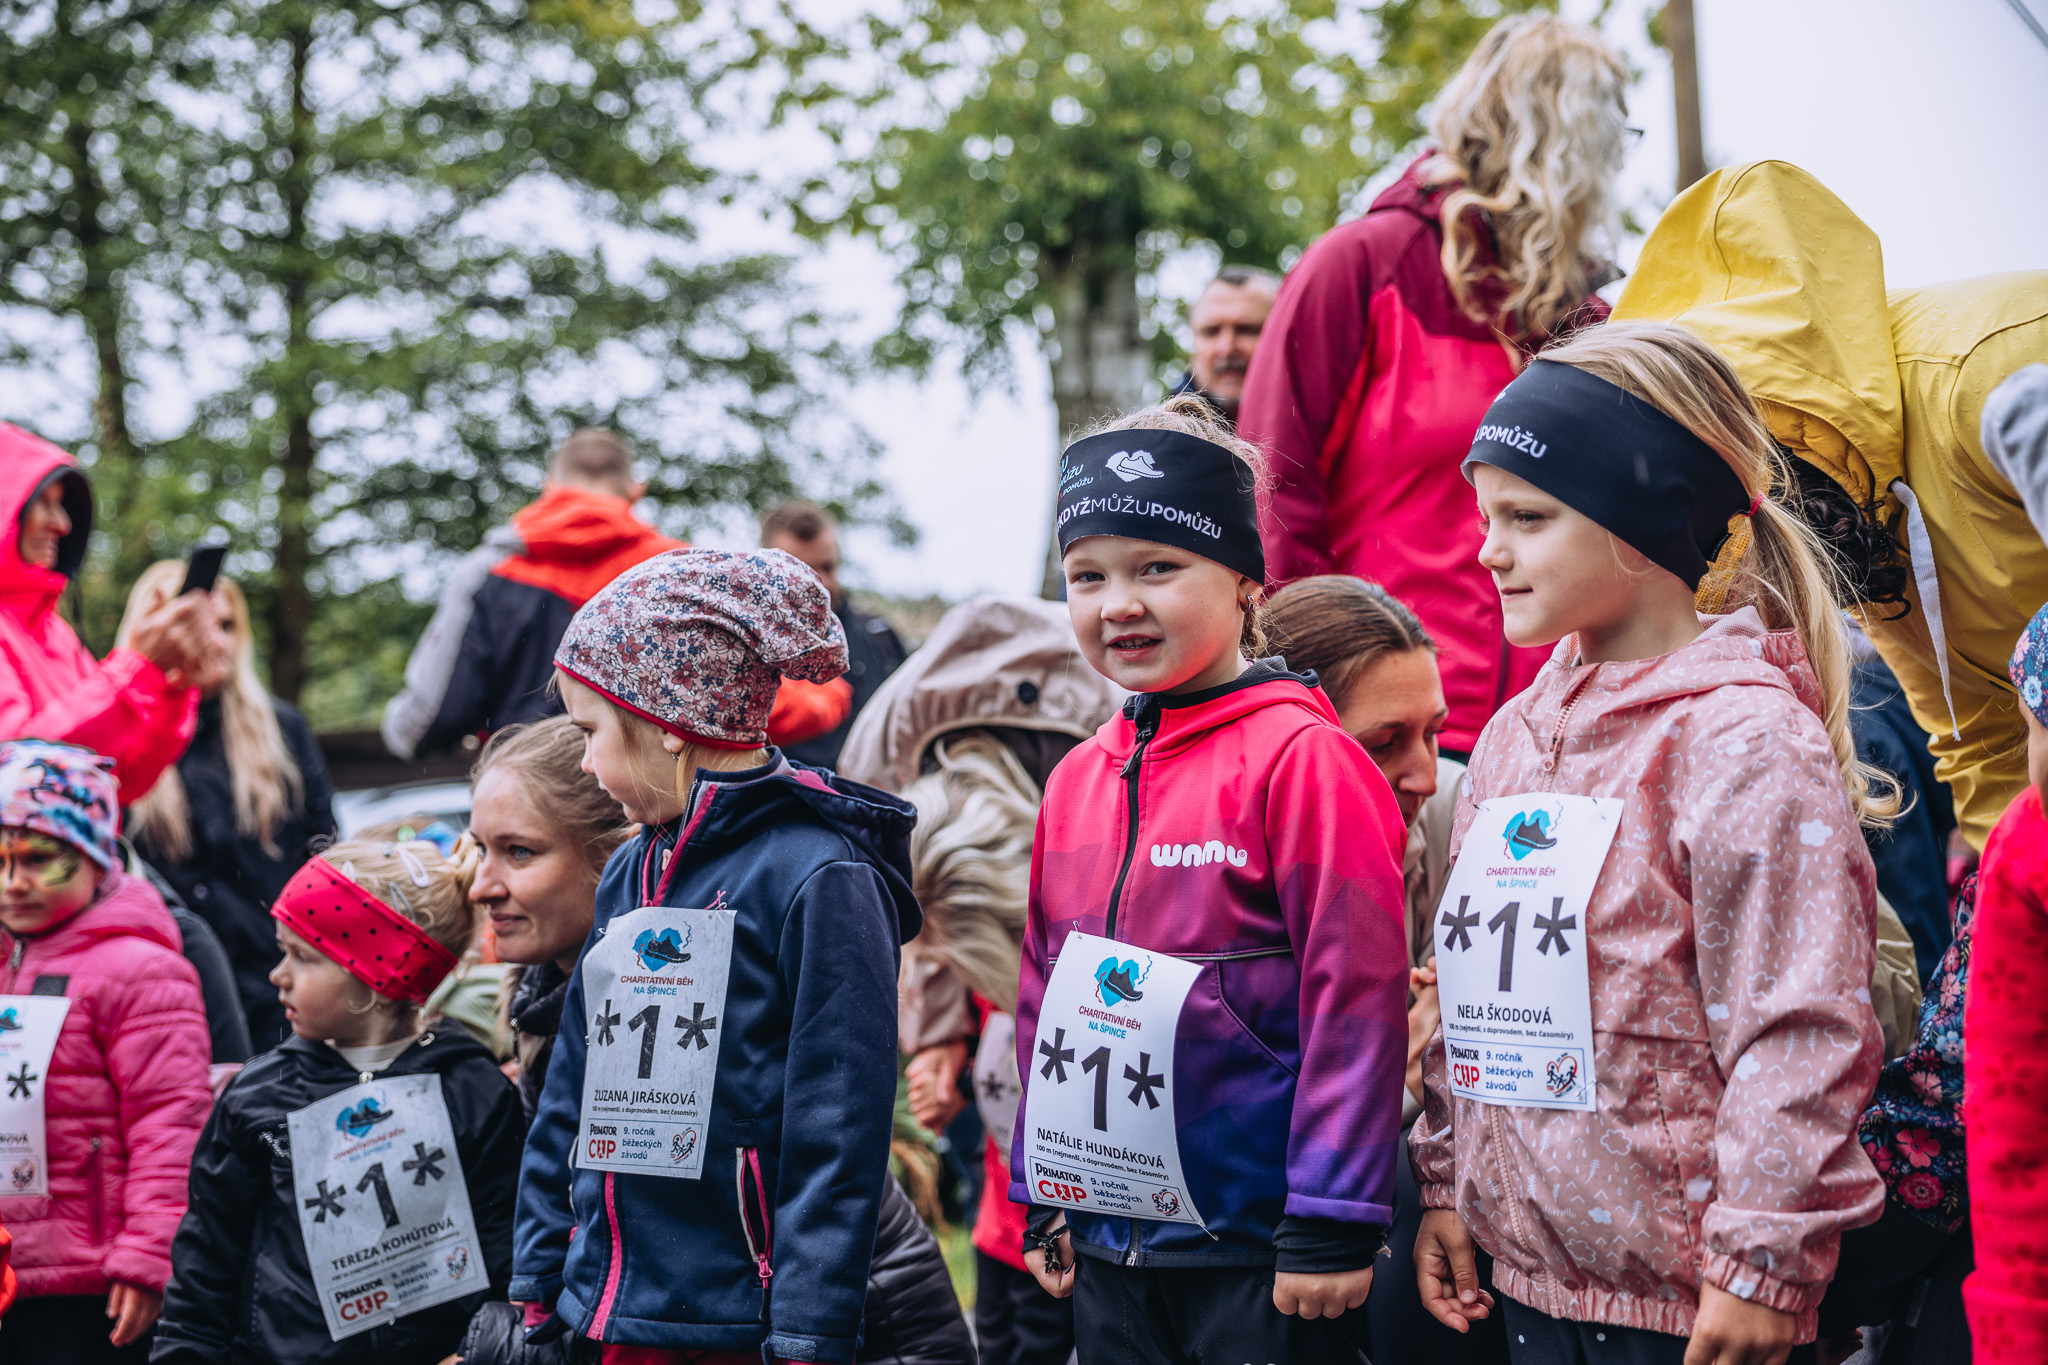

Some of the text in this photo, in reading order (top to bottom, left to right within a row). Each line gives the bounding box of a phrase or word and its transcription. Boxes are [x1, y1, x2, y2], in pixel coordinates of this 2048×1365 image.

[1472, 424, 1547, 458] UPOMŮŽU
[1486, 867, 1555, 876] CHARITATIVNÍ BĚH
[1496, 877, 1538, 888] NA ŠPINCE
[621, 974, 694, 986] CHARITATIVNÍ BĚH
[633, 985, 677, 995] NA ŠPINCE
[1078, 1005, 1141, 1031] CHARITATIVNÍ BĚH
[1457, 1003, 1552, 1024] NELA ŠKODOVÁ
[1088, 1020, 1126, 1039] NA ŠPINCE
[1487, 1027, 1524, 1036] doprovodem,
[1539, 1031, 1573, 1040] časomíry)
[1450, 1044, 1479, 1061] PRIMATOR
[1486, 1051, 1522, 1062] 9. ročník
[1454, 1063, 1479, 1088] CUP
[1486, 1065, 1533, 1079] běžeckých
[1486, 1081, 1517, 1091] závodů
[594, 1088, 696, 1105] ZUZANA JIRÁSKOVÁ
[671, 1109, 698, 1117] časomíry)
[590, 1123, 617, 1136] PRIMATOR
[632, 1127, 655, 1136] ročník
[589, 1139, 616, 1159] CUP
[622, 1139, 662, 1149] běžeckých
[1037, 1127, 1165, 1170] NATÁLIE HUNDÁKOVÁ
[622, 1151, 648, 1159] závodů
[1036, 1144, 1045, 1152] 100
[1052, 1148, 1080, 1163] (nejmenší,
[1086, 1155, 1125, 1173] doprovodem,
[1127, 1166, 1138, 1174] bez
[1138, 1167, 1169, 1181] časomíry)
[1035, 1162, 1083, 1184] PRIMATOR
[1038, 1180, 1087, 1204] CUP
[1090, 1177, 1130, 1192] 9. ročník
[1094, 1188, 1143, 1204] běžeckých
[1098, 1198, 1132, 1211] závodů
[331, 1215, 454, 1271] TEREZA KOHÚTOVÁ
[340, 1290, 388, 1321] CUP
